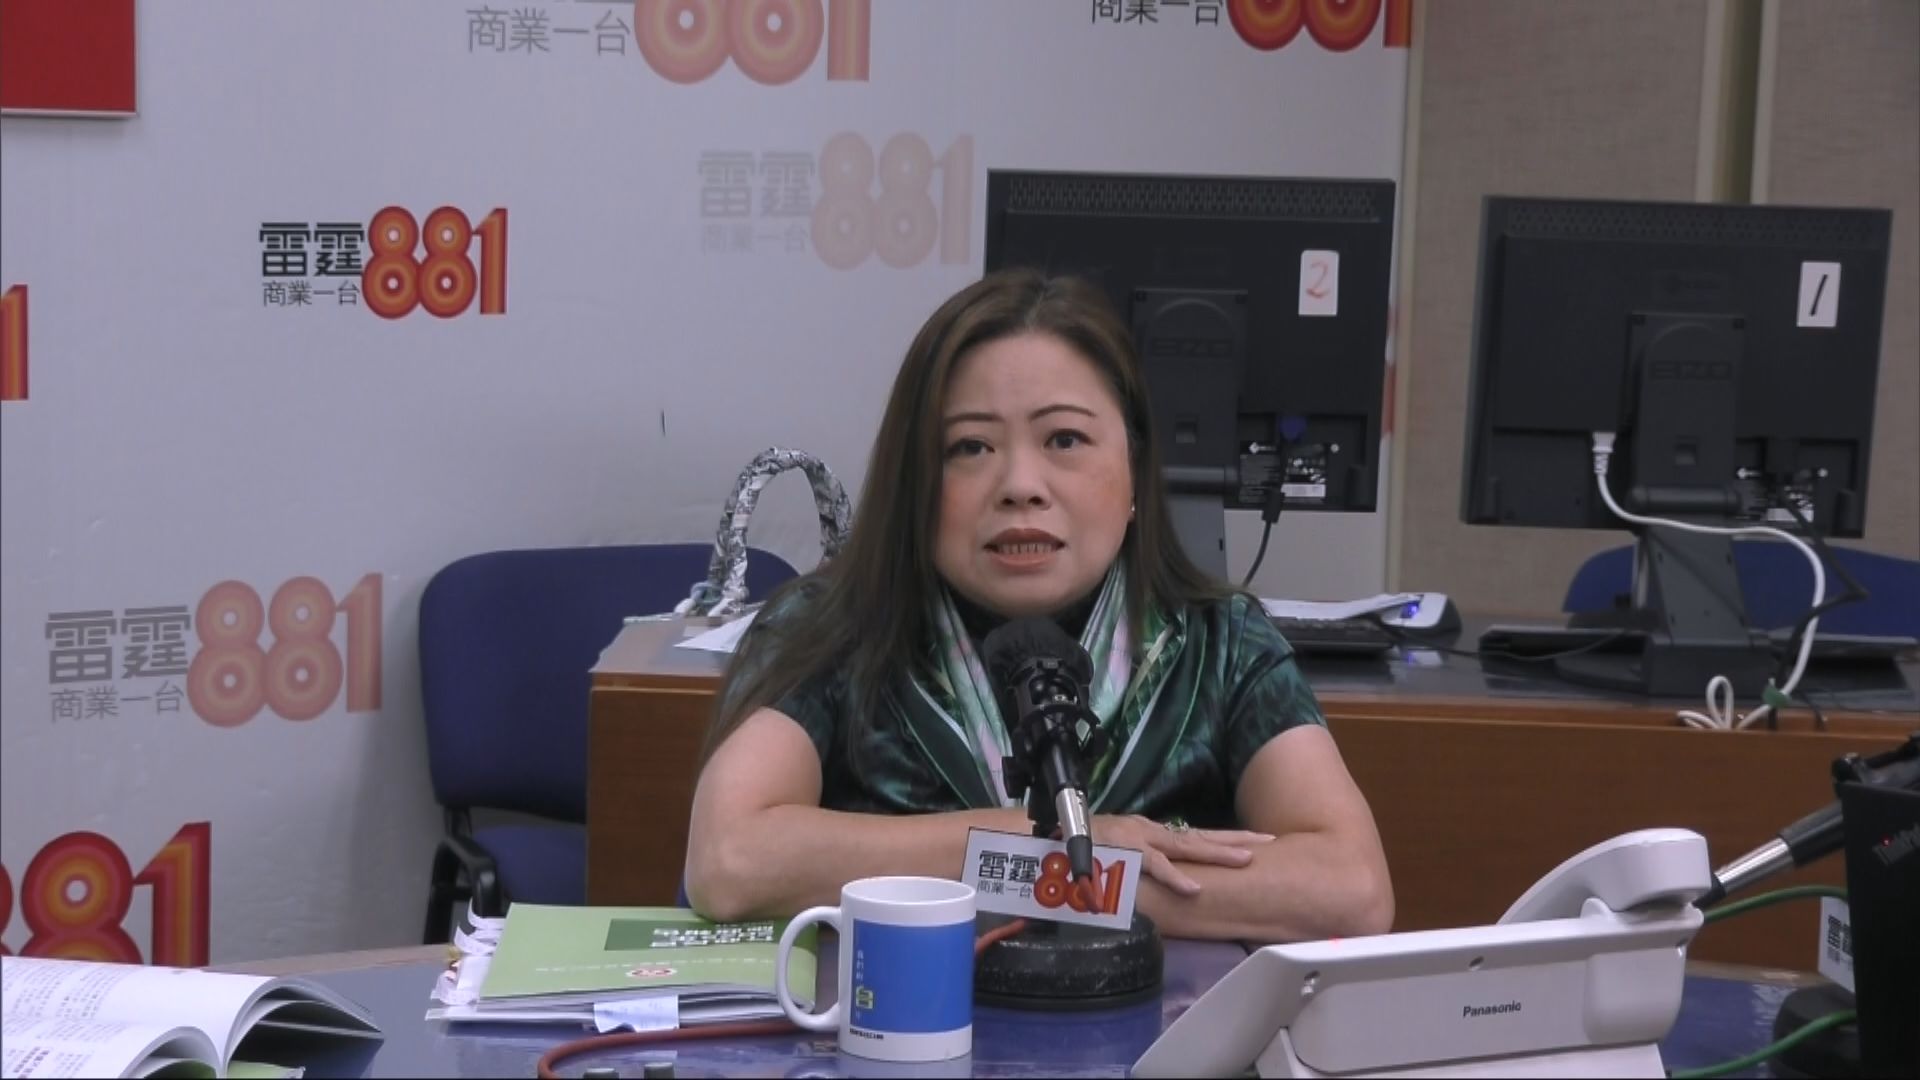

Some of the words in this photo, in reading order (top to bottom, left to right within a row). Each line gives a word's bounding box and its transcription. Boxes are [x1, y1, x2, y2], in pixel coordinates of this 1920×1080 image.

[465, 7, 632, 57] 商業一台
[696, 150, 815, 219] 雷霆
[810, 131, 974, 270] 881
[259, 222, 365, 277] 雷霆
[360, 205, 508, 320] 881
[1306, 262, 1330, 299] 2
[262, 280, 362, 307] 商業一台
[44, 604, 188, 685] 雷霆
[184, 572, 384, 728] 881
[48, 680, 183, 724] 商業一台
[977, 850, 1040, 883] 雷霆
[1462, 1000, 1523, 1019] Panasonic
